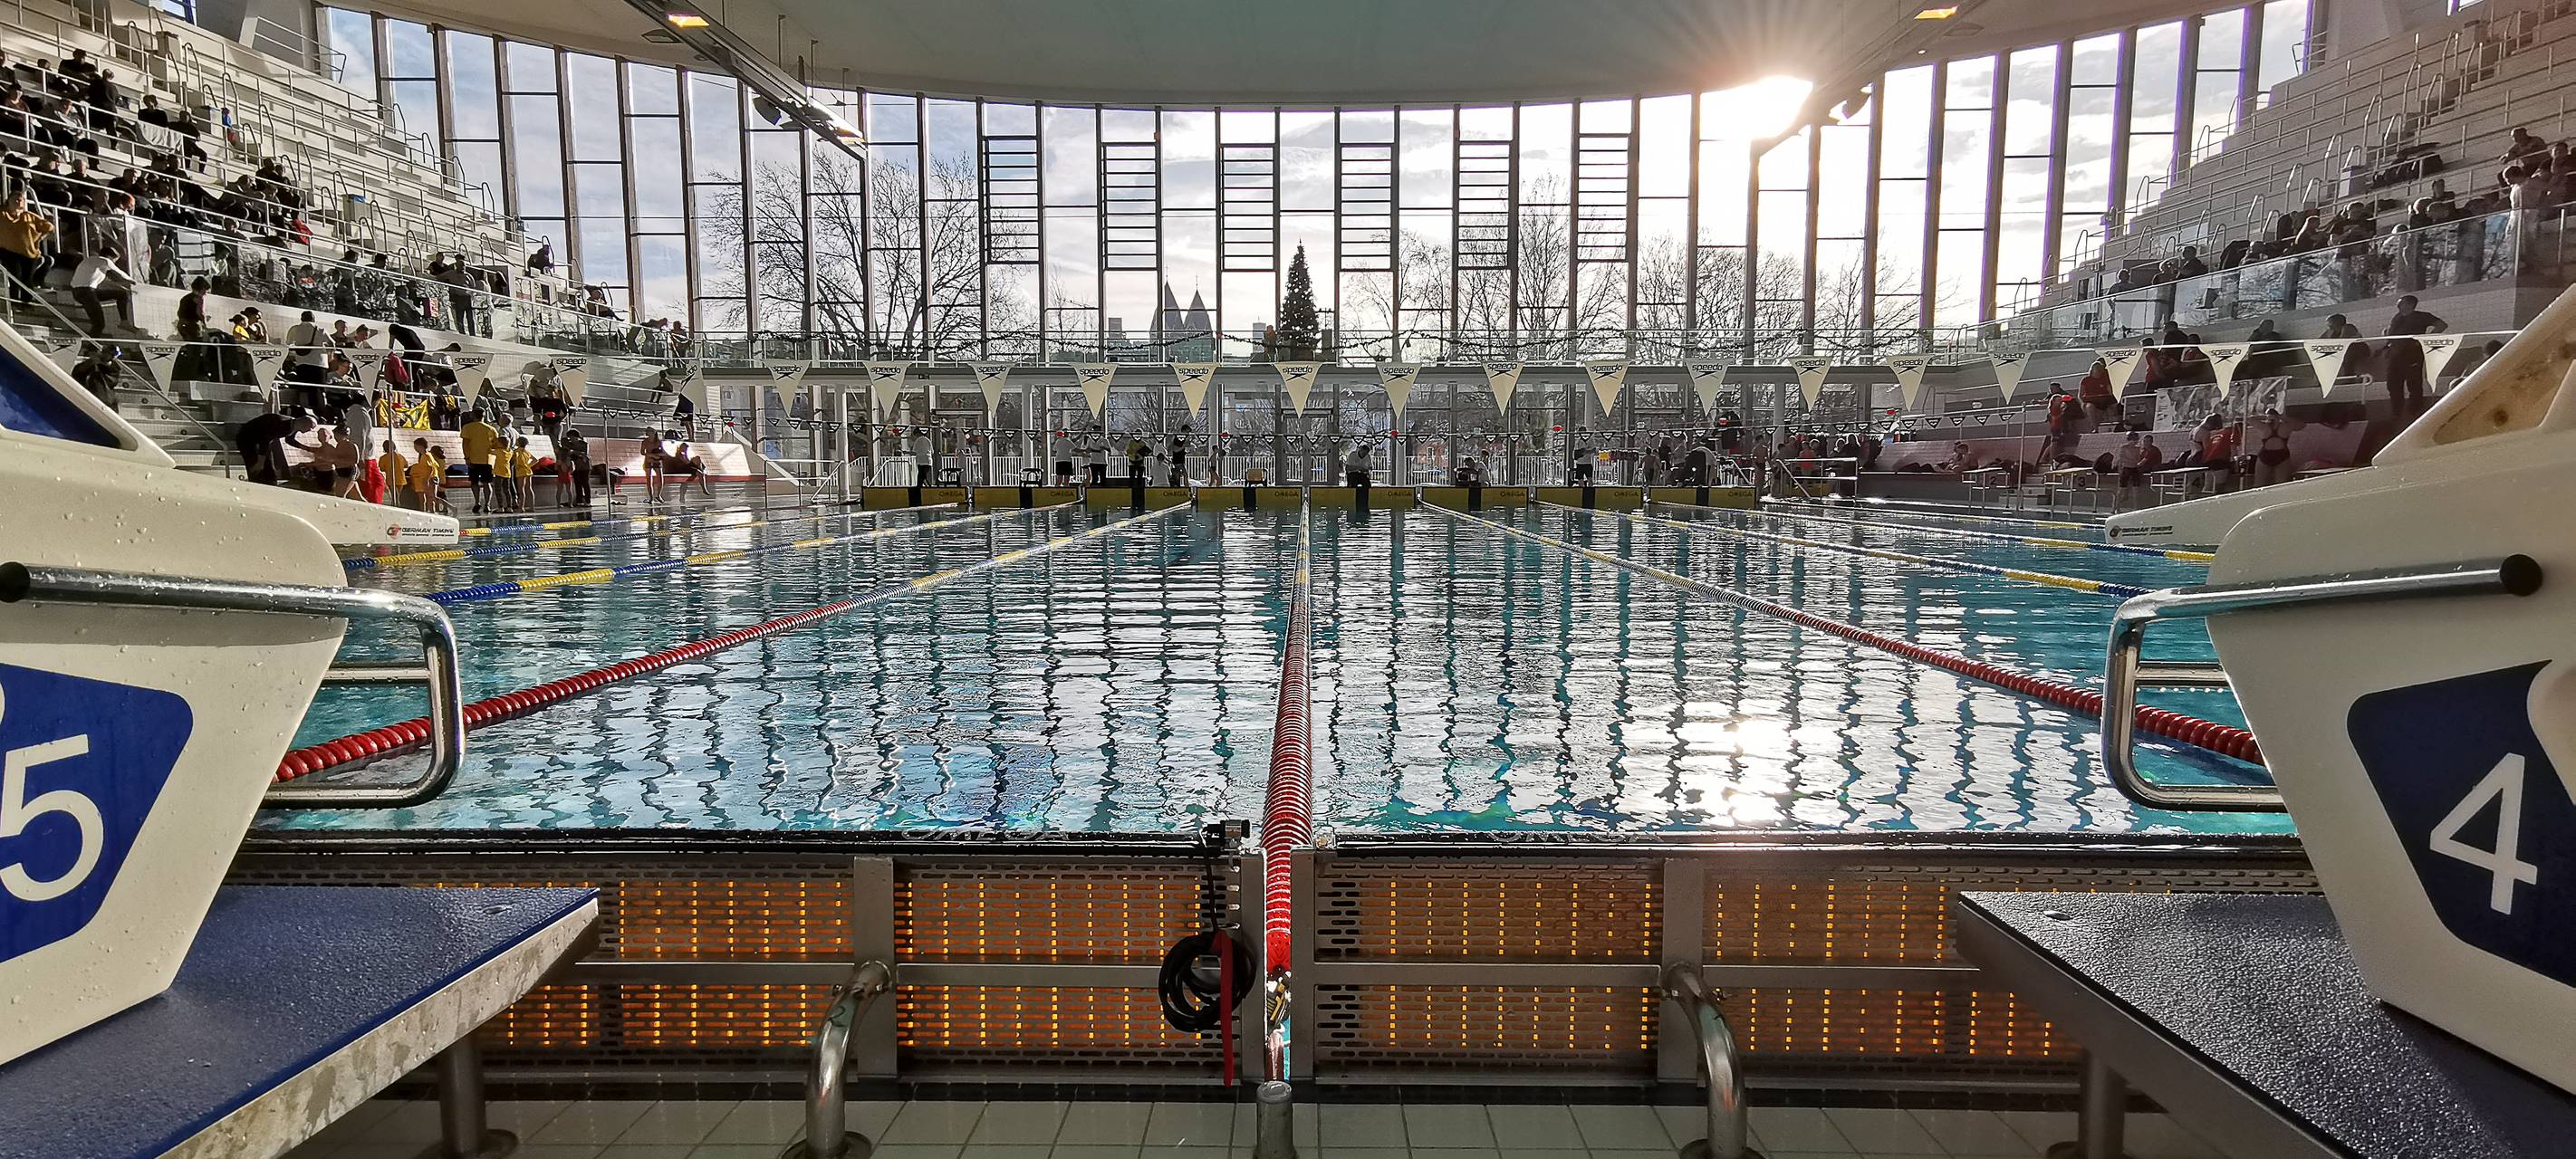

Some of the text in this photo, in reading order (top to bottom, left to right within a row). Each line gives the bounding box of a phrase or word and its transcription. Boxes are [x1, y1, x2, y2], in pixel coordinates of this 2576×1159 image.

[2312, 343, 2344, 352] speedo
[2423, 339, 2454, 348] speedo
[253, 349, 282, 358] speedo
[2105, 350, 2137, 358] speedo
[2211, 348, 2242, 357] speedo
[352, 354, 380, 362] speedo
[454, 357, 486, 365] speedo
[556, 357, 587, 365] speedo
[1487, 362, 1518, 371] speedo
[1590, 363, 1622, 372] speedo
[1692, 363, 1723, 371] speedo
[1795, 359, 1826, 368] speedo
[1893, 359, 1924, 368] speedo
[772, 365, 801, 374] speedo
[870, 366, 901, 374] speedo
[977, 365, 1007, 373] speedo
[1080, 368, 1110, 376] speedo
[1179, 367, 1209, 376] speedo
[1283, 366, 1313, 374] speedo
[1383, 366, 1415, 375] speedo
[2078, 476, 2086, 487] 3
[0, 734, 104, 902] 5
[2429, 752, 2537, 915] 4
